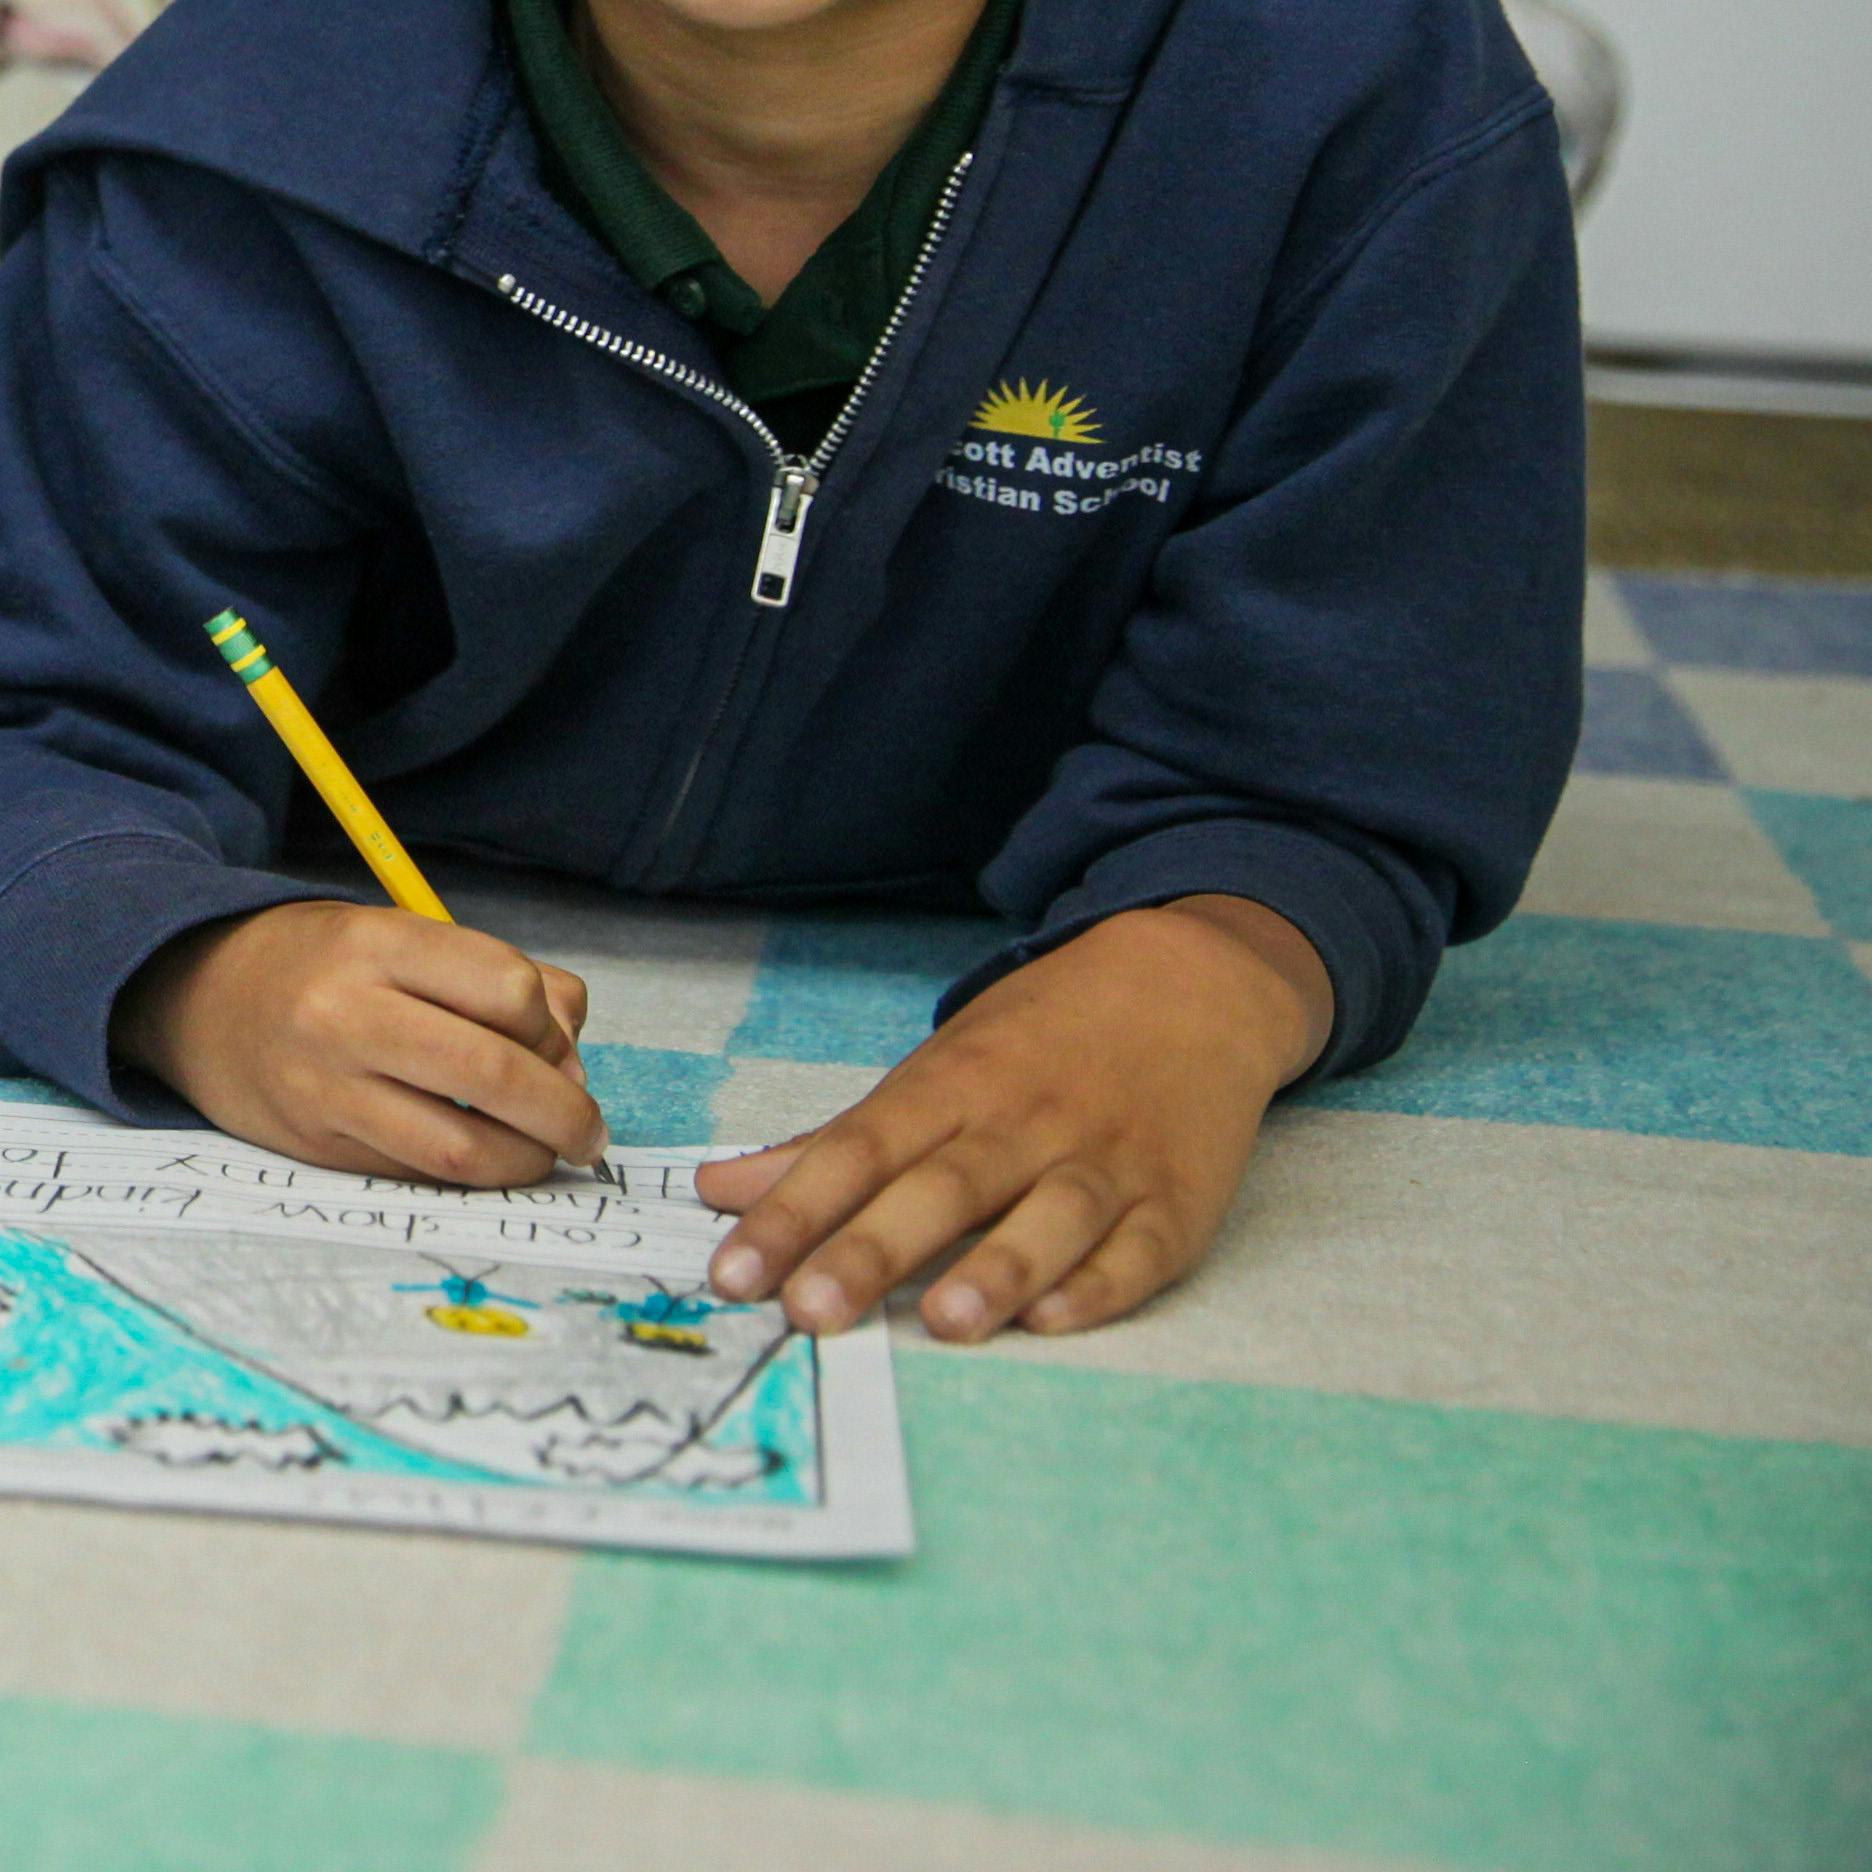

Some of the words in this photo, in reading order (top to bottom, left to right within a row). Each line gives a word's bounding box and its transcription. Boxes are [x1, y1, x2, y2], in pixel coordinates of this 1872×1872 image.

[1024, 442, 1204, 481] Adventist
[155, 1153, 297, 1189] my
[253, 1202, 440, 1243] show
[499, 1219, 642, 1249] can
